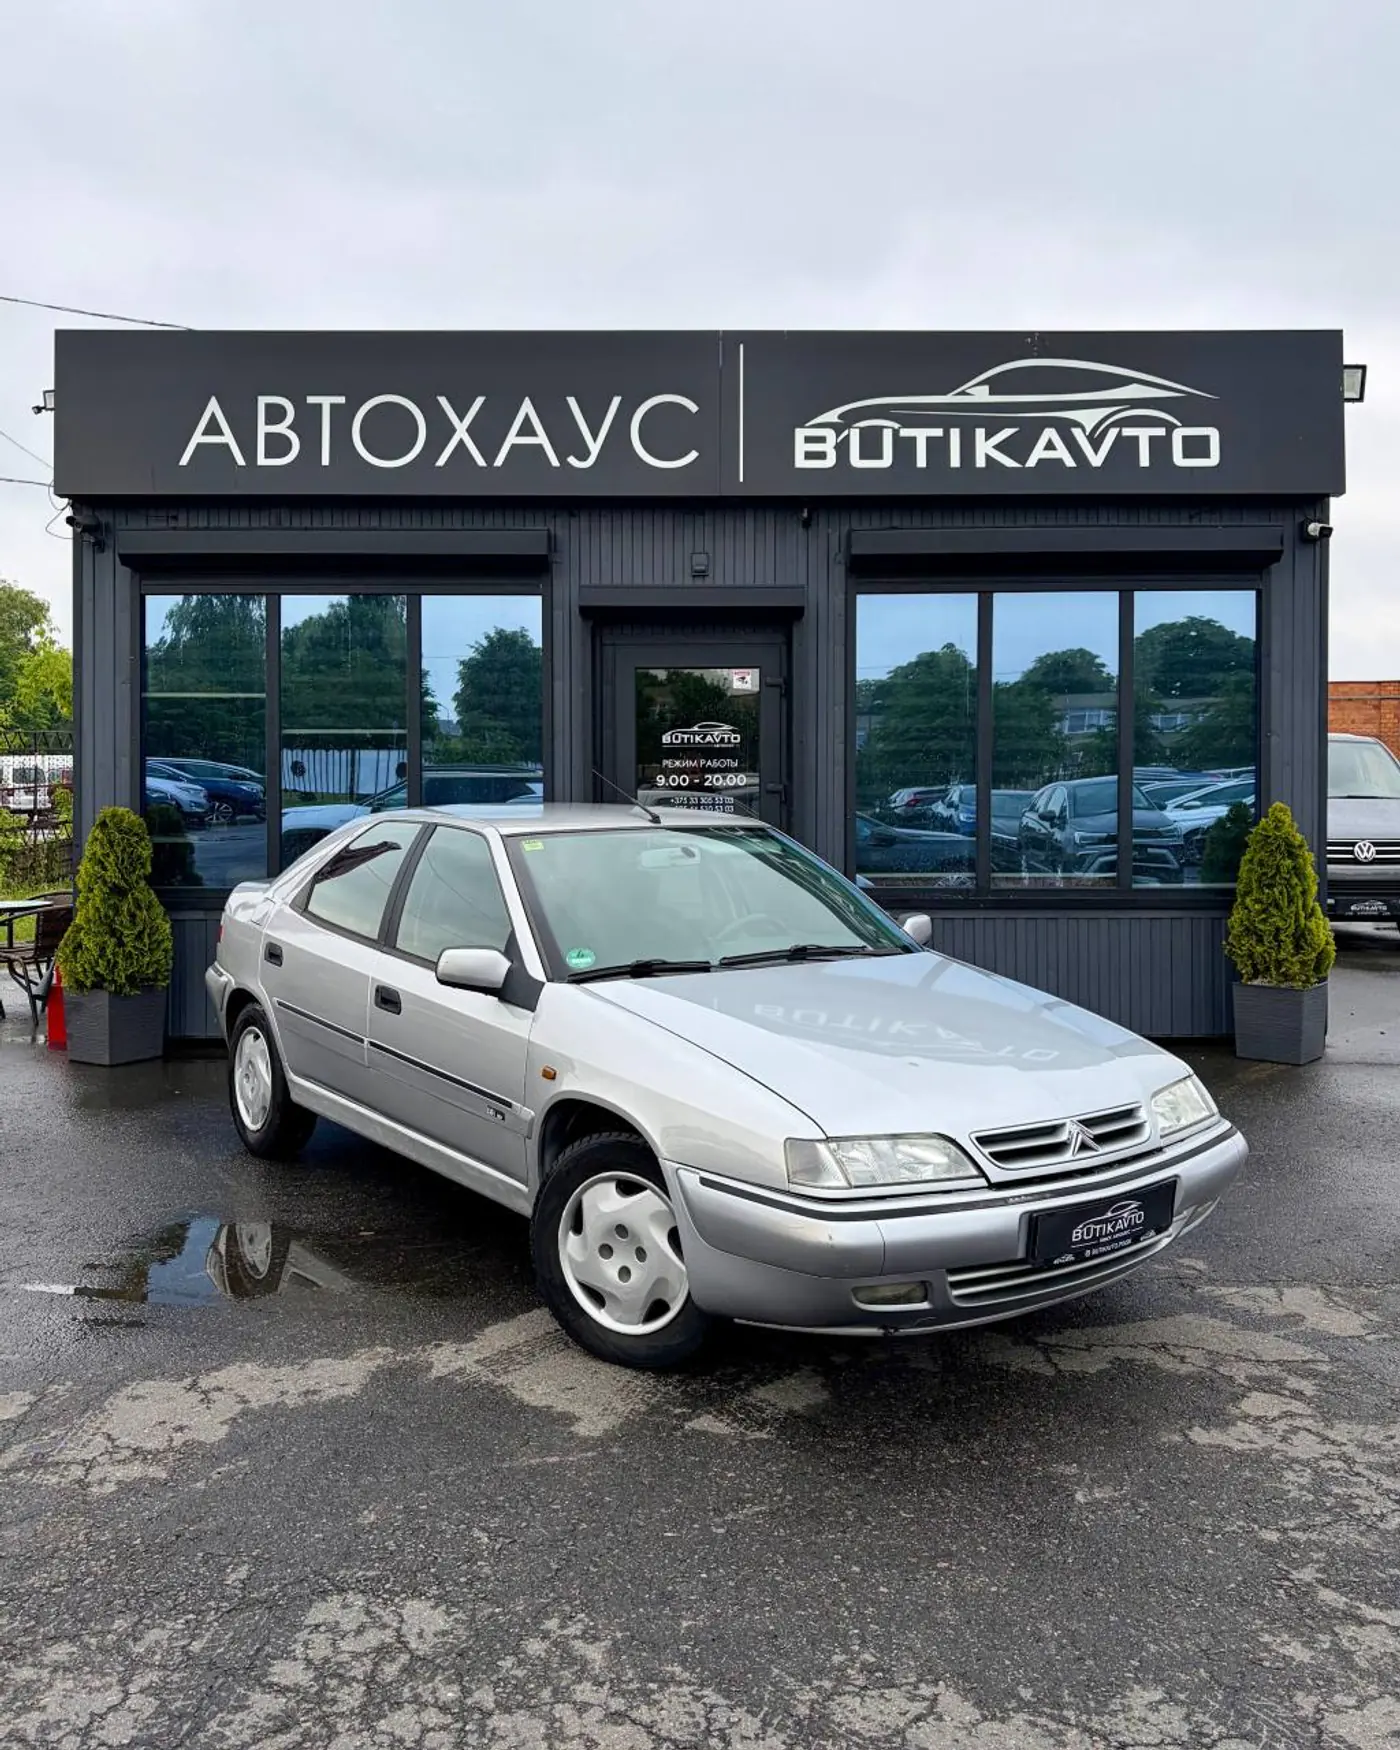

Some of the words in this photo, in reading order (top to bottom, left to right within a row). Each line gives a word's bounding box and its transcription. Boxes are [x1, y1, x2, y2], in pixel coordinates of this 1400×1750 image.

[179, 393, 700, 469] АВТОХАУС
[794, 426, 1221, 469] BUTIKAVTO
[661, 733, 741, 744] BUTIKAVTO
[662, 759, 698, 768] РЕЖИМ
[700, 759, 739, 768] РАБОТЫ
[656, 774, 690, 787] 9.00
[704, 774, 747, 787] 20.00
[1071, 1211, 1145, 1242] BUTIKAVTO
